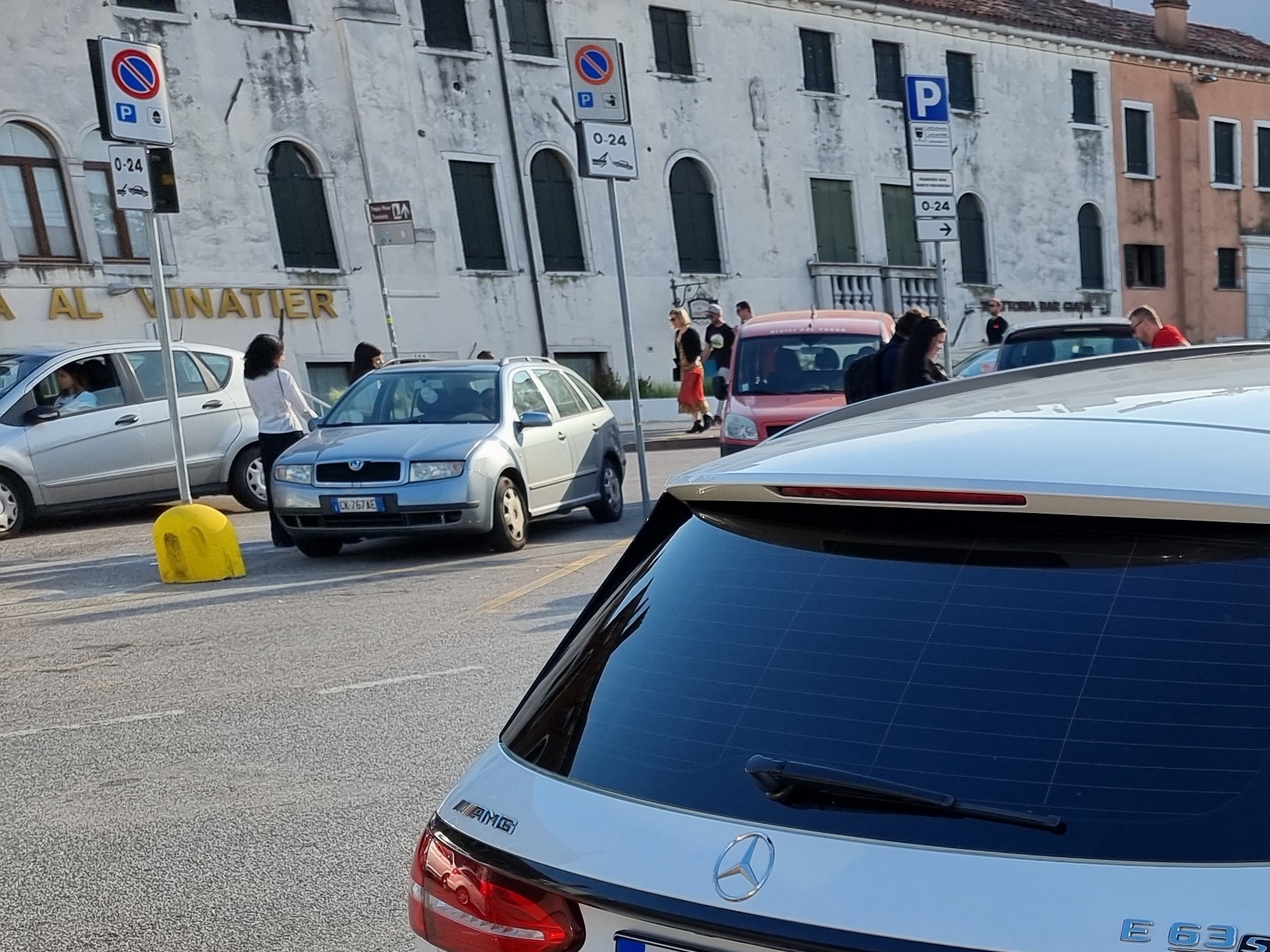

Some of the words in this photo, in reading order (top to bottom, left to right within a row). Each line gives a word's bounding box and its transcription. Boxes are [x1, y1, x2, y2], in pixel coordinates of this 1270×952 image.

[581, 93, 591, 106] P
[915, 80, 942, 117] P
[120, 105, 132, 120] P
[593, 132, 627, 146] 0-24
[114, 157, 143, 173] 0-24
[922, 201, 950, 211] 0-24
[50, 287, 104, 320] AL
[471, 806, 518, 835] AMG
[1120, 918, 1154, 943] E
